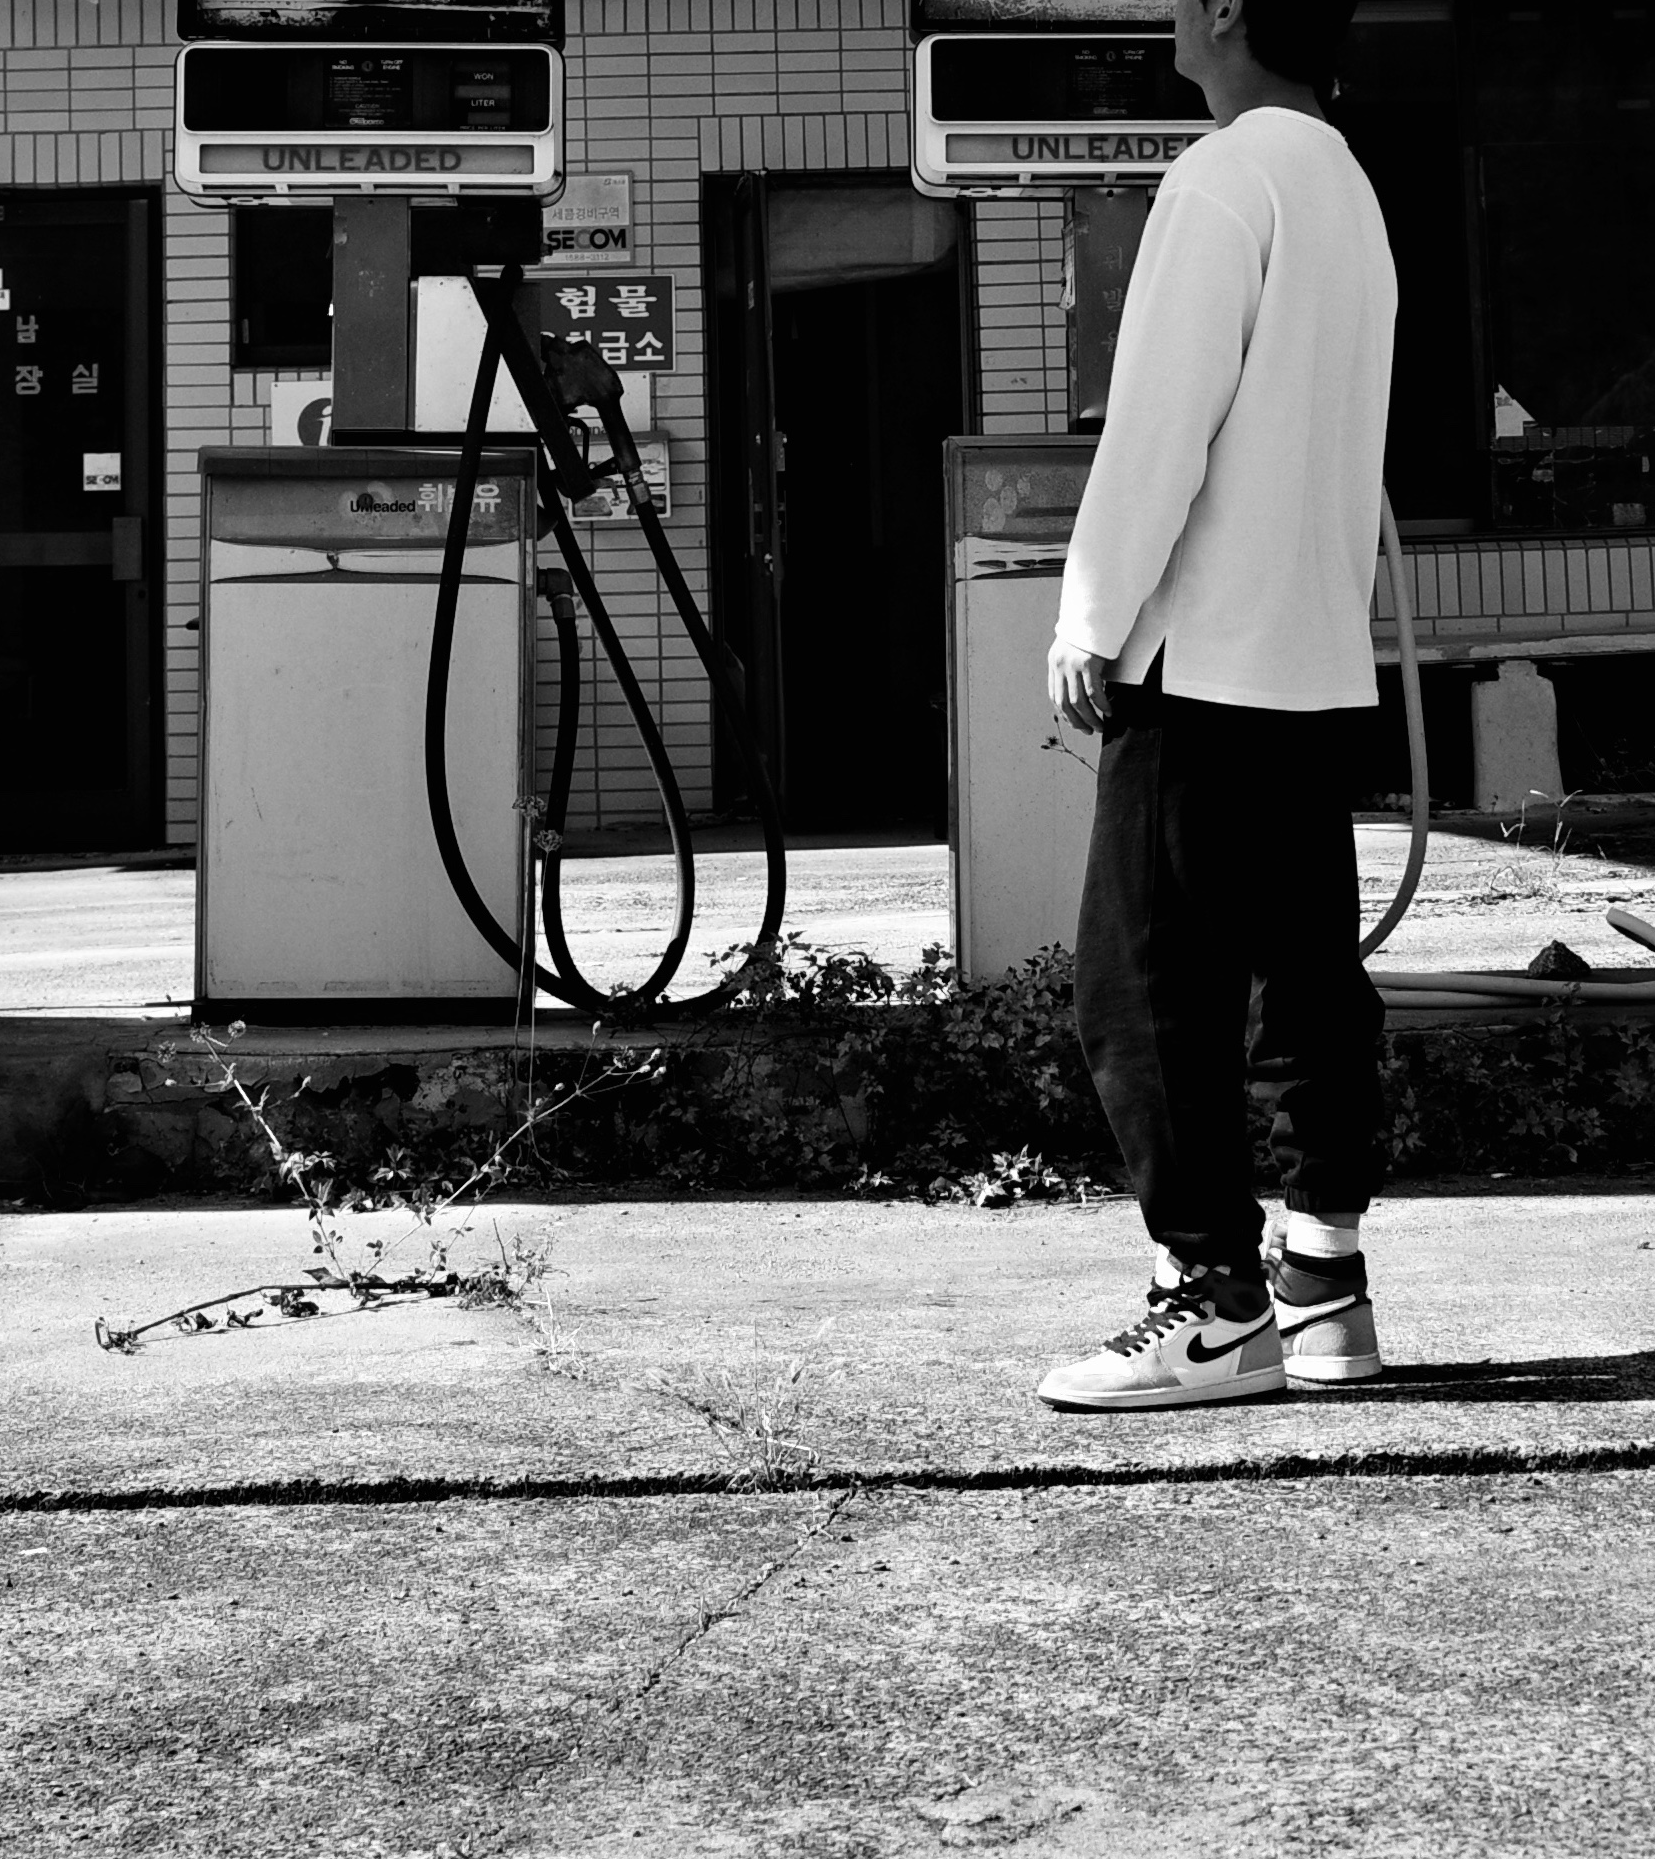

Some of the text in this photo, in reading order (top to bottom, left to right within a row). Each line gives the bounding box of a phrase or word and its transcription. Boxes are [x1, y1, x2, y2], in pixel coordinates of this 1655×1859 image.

[474, 73, 494, 81] WON
[471, 99, 495, 107] LITER
[263, 148, 462, 171] UNLEADED
[552, 206, 620, 220] 세콤경비구역
[547, 228, 627, 250] SECOM
[15, 314, 40, 344] 남
